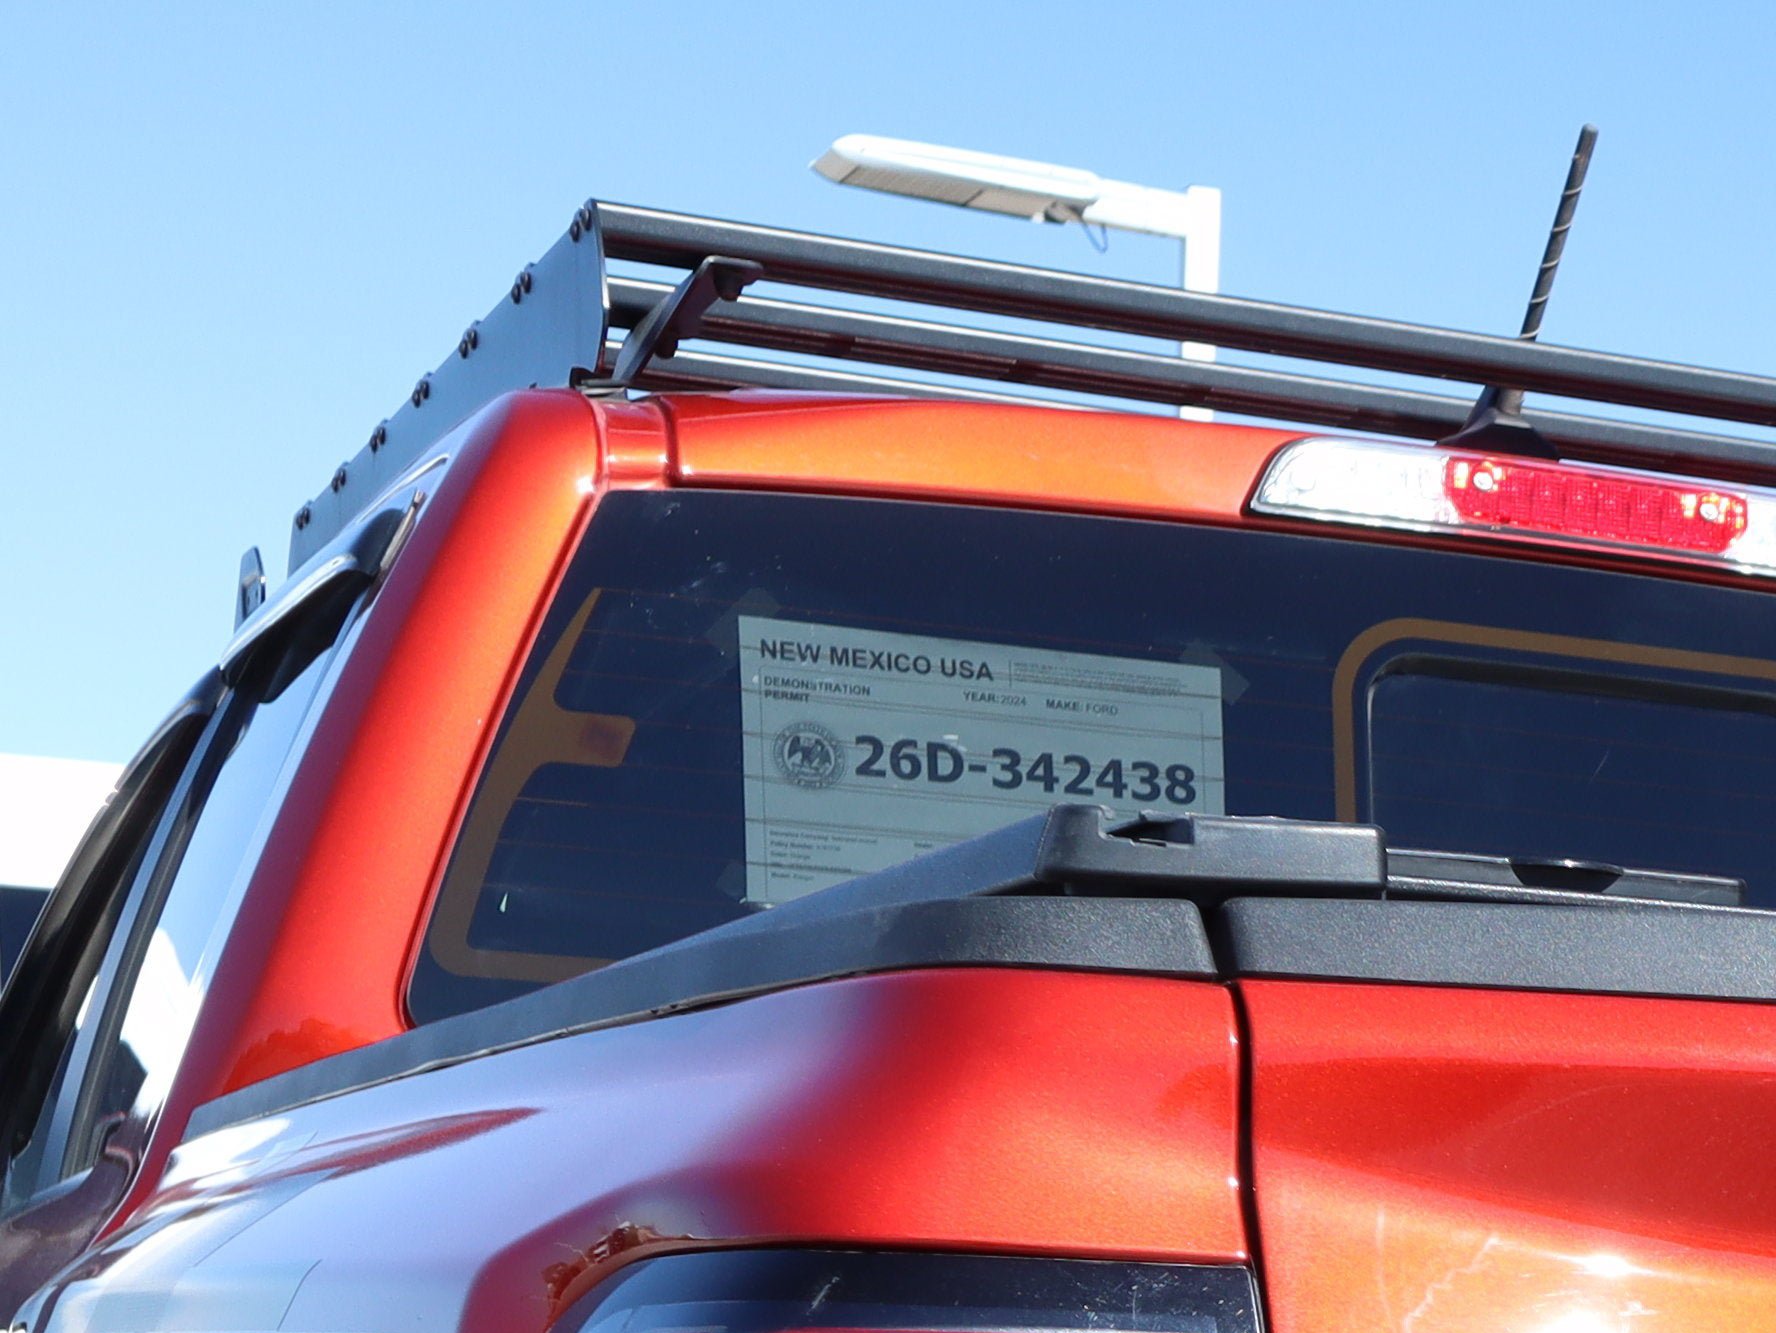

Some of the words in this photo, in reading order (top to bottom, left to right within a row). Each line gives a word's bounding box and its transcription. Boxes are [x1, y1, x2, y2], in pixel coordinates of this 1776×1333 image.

[760, 638, 822, 664] NEW
[829, 646, 932, 675] MEXICO
[940, 657, 994, 681] USA
[764, 675, 871, 697] DEMONSTRATION
[764, 689, 810, 703] PERMIT
[1086, 703, 1119, 717] FORD
[854, 734, 1197, 805] 26D-342438
